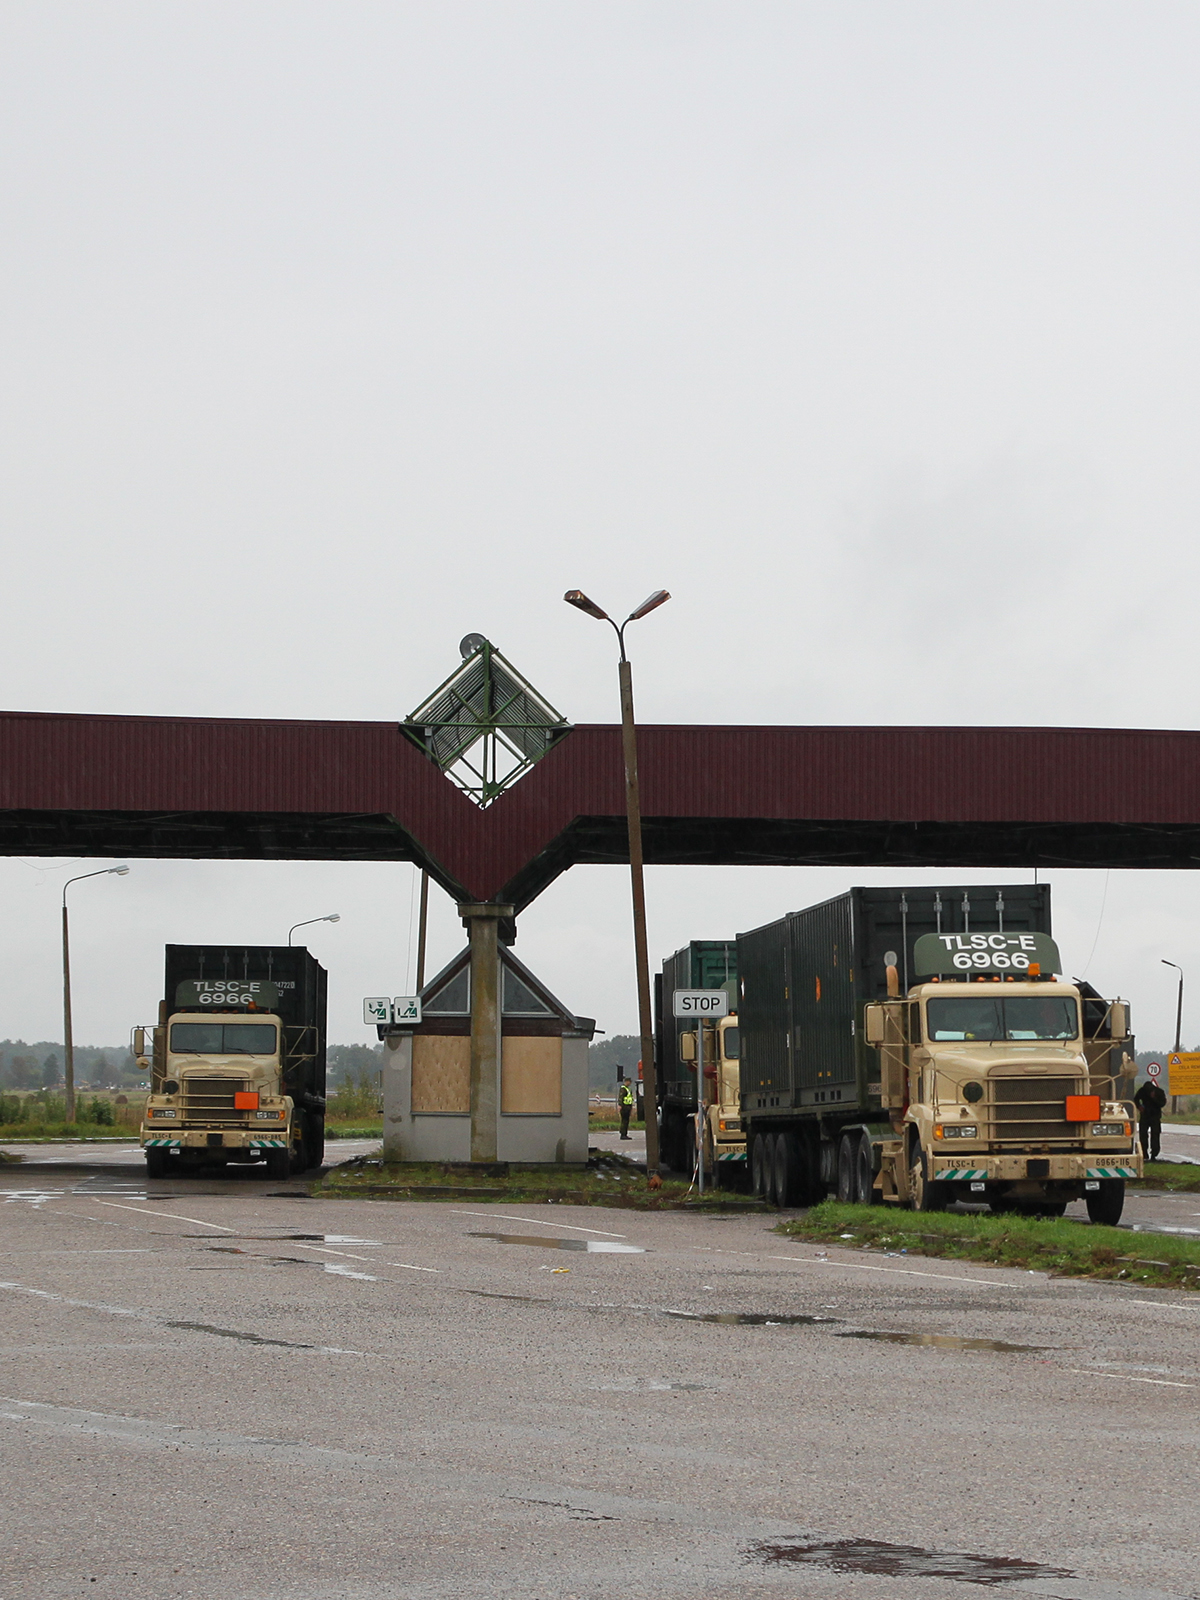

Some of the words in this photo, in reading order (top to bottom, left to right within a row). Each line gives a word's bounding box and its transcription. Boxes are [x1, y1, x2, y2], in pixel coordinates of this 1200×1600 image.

[938, 934, 1037, 950] TLSC-E
[952, 951, 1030, 969] 6966
[193, 981, 261, 993] TLSC-E
[198, 993, 253, 1005] 6966
[682, 996, 721, 1011] STOP
[1150, 1066, 1158, 1074] 70
[947, 1160, 976, 1168] TLSC-E
[1095, 1158, 1130, 1166] 6966-116
